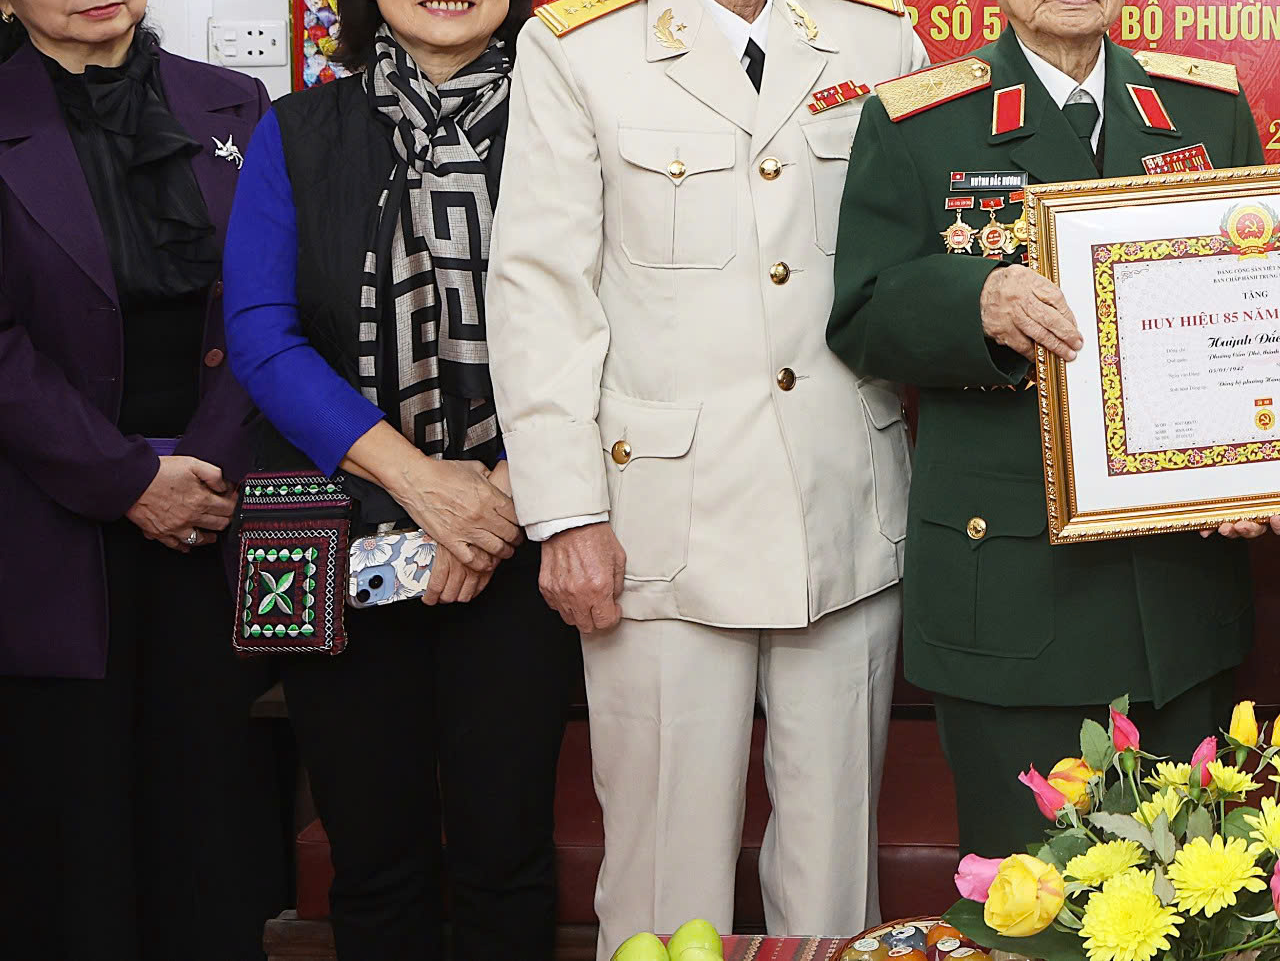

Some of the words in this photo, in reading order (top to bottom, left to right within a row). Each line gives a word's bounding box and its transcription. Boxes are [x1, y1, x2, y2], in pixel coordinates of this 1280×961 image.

[1121, 0, 1164, 48] BỘ
[1242, 290, 1268, 301] TẶNG
[1141, 316, 1176, 331] HUY
[1180, 310, 1220, 329] HIỆU
[1223, 310, 1239, 324] 85
[1243, 304, 1279, 322] NĂM
[1208, 335, 1252, 348] Huỳnh
